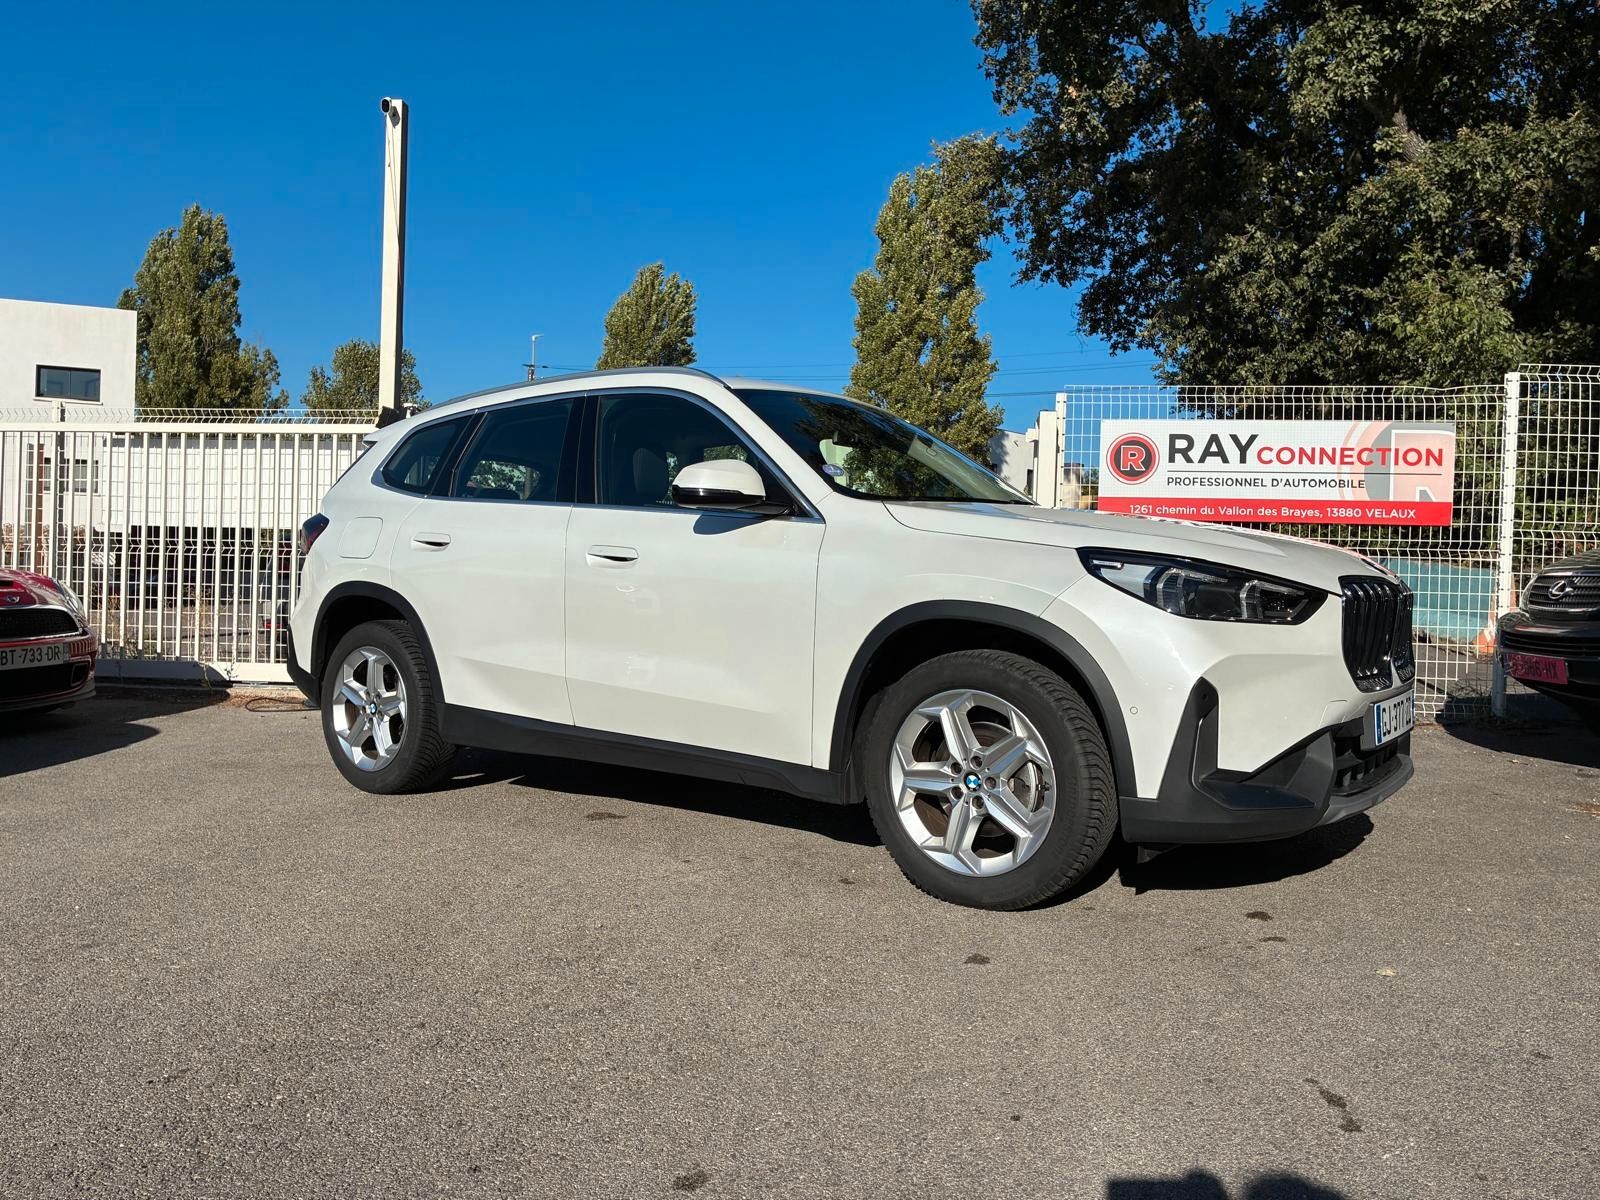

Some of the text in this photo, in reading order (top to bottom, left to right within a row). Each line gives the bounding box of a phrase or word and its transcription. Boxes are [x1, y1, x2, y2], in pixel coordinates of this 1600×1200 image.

[1120, 445, 1146, 471] R
[1168, 433, 1443, 466] RAY CONNECTION
[1167, 476, 1365, 489] PROFESSIONNEL D'AUTOMOBILE
[1129, 504, 1416, 519] 1261 chemin du Vallon des Brayes, 13880 VELAUX
